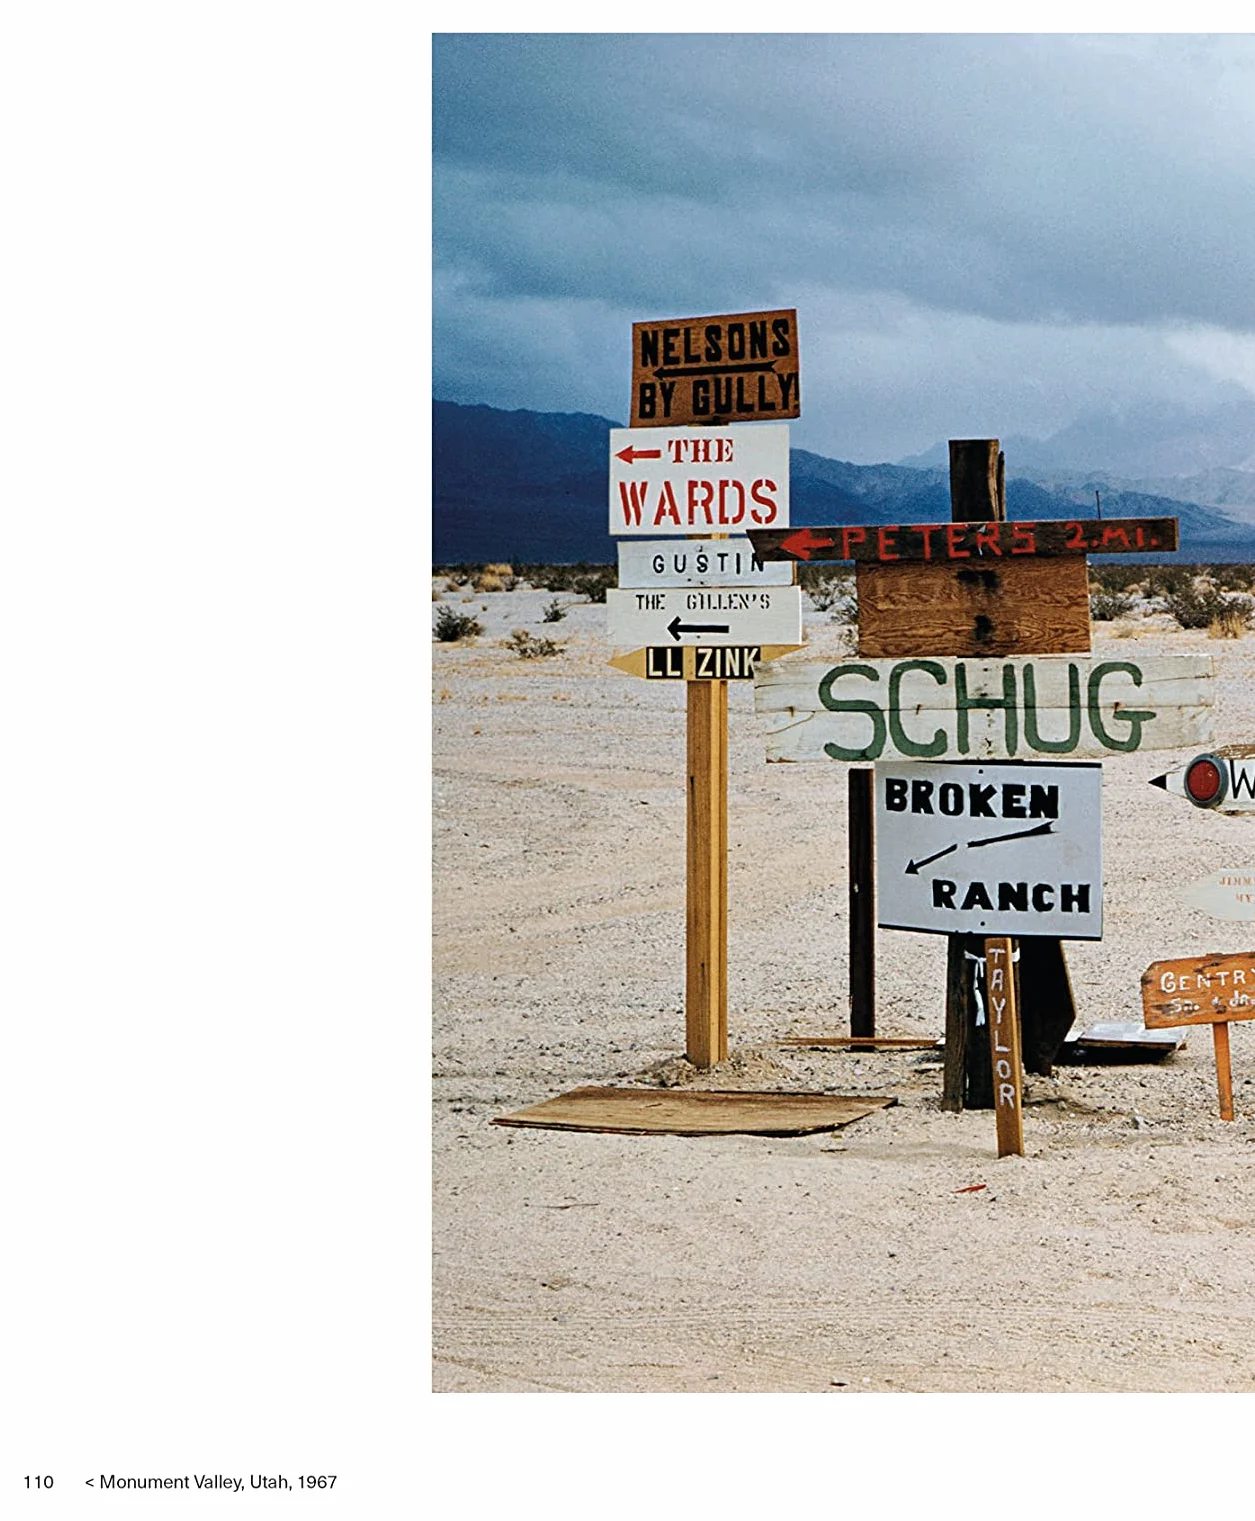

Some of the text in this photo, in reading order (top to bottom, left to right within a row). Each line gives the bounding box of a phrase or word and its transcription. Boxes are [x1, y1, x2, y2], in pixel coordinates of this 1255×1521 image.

[641, 319, 790, 367] NELSONS
[639, 381, 676, 419] BY
[667, 438, 734, 463] THE
[619, 479, 778, 526] WARDS
[842, 522, 1036, 560] PETERS
[652, 553, 764, 574] GUSTIN
[635, 593, 770, 610] THE GILLEN'S
[648, 648, 759, 678] LL ZINK
[818, 660, 1158, 761] SCHUG
[885, 778, 1060, 819] BROKEN
[932, 879, 1091, 914] RANCH
[988, 947, 1016, 1110] TAYLOR
